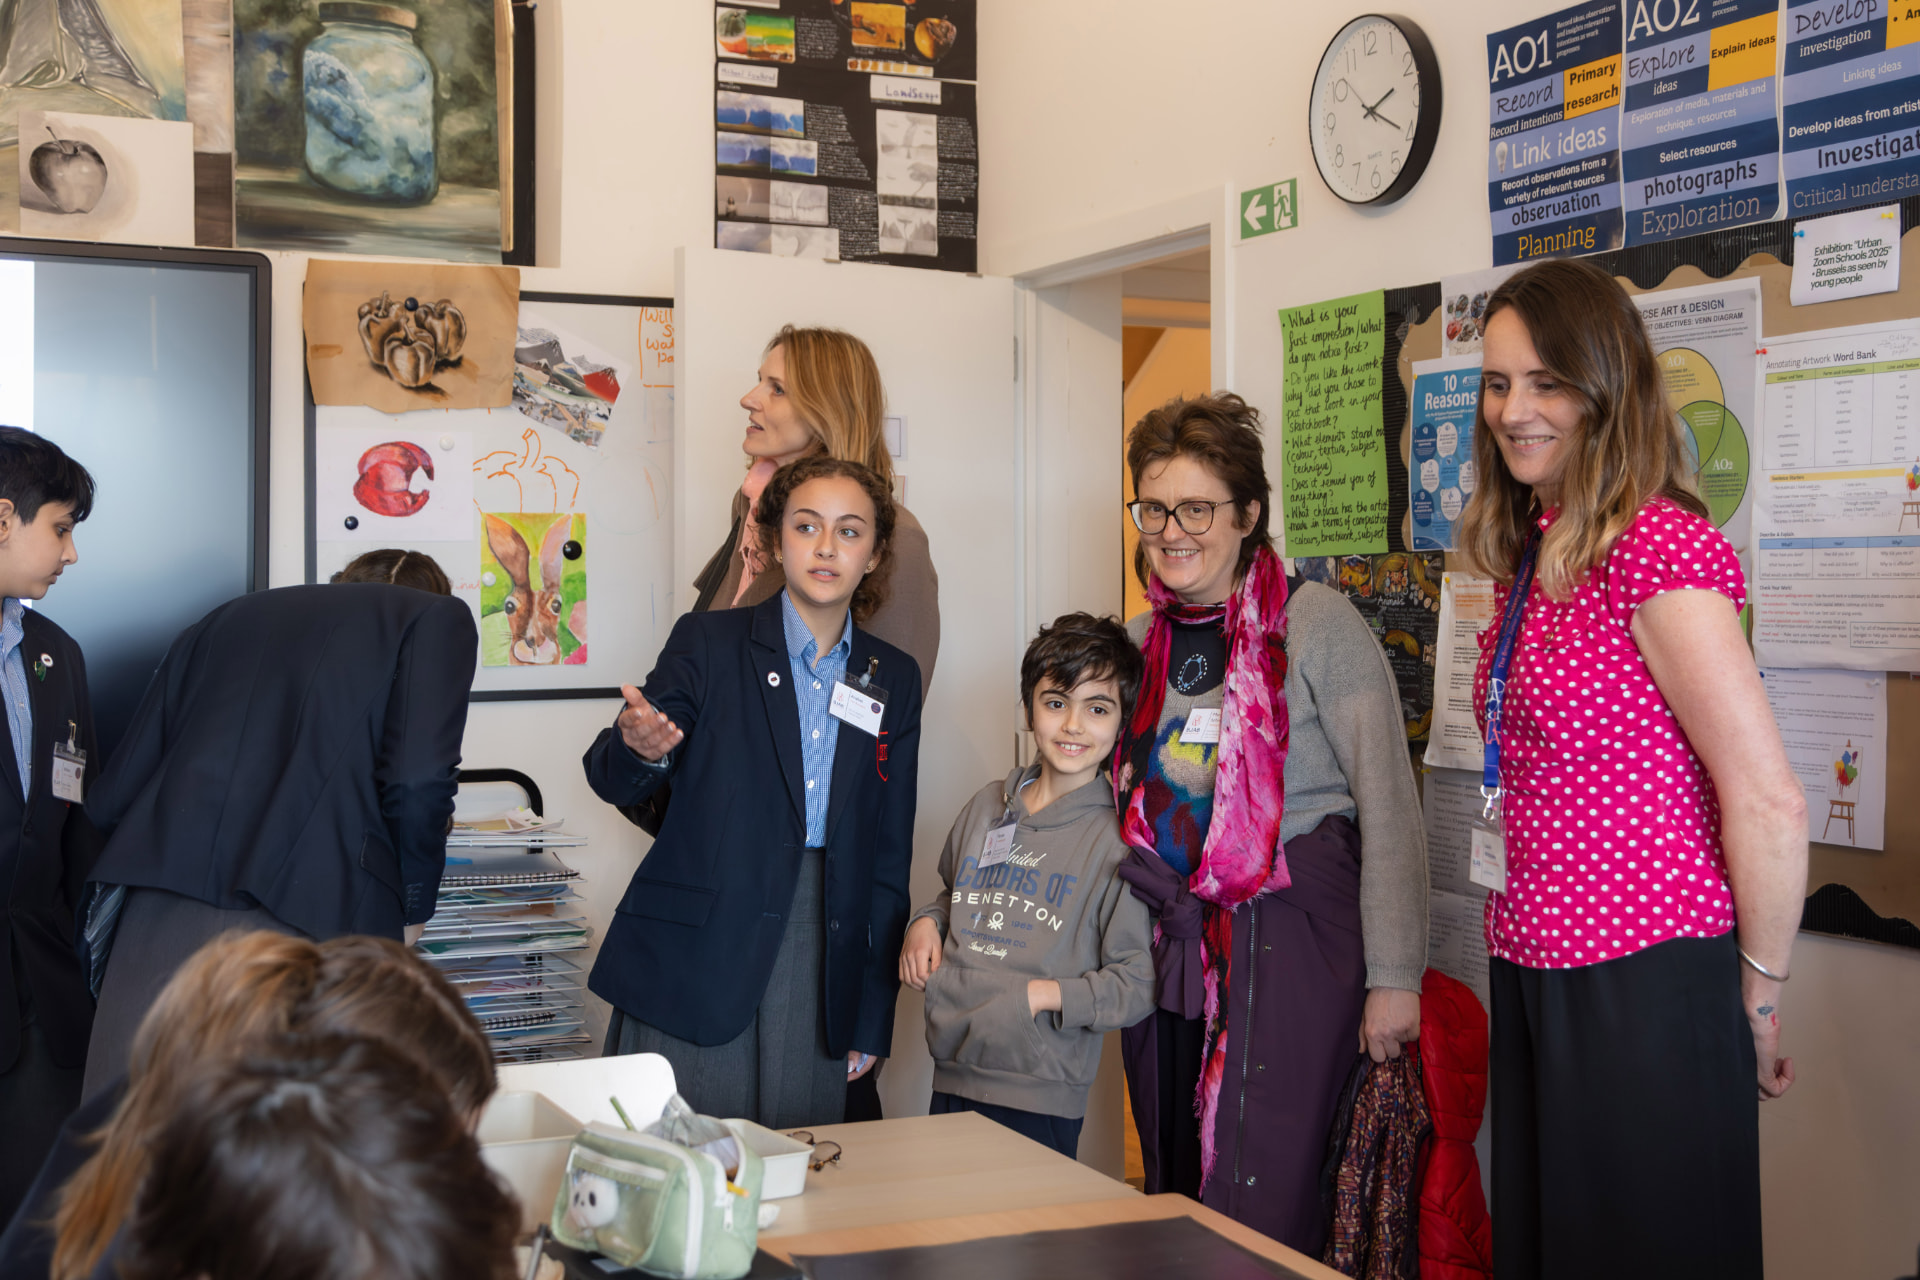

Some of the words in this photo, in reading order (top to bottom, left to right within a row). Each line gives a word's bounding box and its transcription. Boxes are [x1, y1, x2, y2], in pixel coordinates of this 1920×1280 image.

[1628, 0, 1700, 42] AO2
[1795, 0, 1877, 34] Develop
[1363, 30, 1377, 56] 12
[1388, 31, 1393, 55] 1
[1711, 43, 1746, 59] Explain
[1749, 34, 1776, 49] ideas
[1799, 29, 1871, 57] investigation
[1345, 48, 1356, 73] 11
[1402, 51, 1414, 77] 2
[1491, 30, 1552, 83] AO1
[1628, 44, 1695, 79] Explore
[1570, 63, 1616, 85] Primary
[1843, 67, 1875, 83] Linking
[1878, 60, 1902, 74] ideas
[1332, 78, 1348, 104] 10
[1497, 78, 1553, 115] Record
[1566, 84, 1619, 111] research
[1653, 80, 1678, 96] ideas
[1631, 103, 1673, 124] Exploration
[1675, 101, 1683, 113] of
[1712, 86, 1748, 104] materials
[1750, 81, 1766, 94] and
[1697, 107, 1737, 124] resources
[1326, 112, 1336, 136] 9
[1405, 120, 1414, 142] 4
[1490, 120, 1518, 139] Record
[1521, 110, 1563, 130] intentions
[1789, 121, 1832, 138] Develop
[1834, 113, 1863, 128] ideas
[1865, 108, 1890, 122] from
[1335, 144, 1344, 168] 8
[1512, 135, 1552, 169] Link
[1558, 126, 1606, 157] ideas
[1660, 147, 1688, 163] Select
[1690, 139, 1737, 157] resources
[1352, 162, 1361, 186] 7
[1391, 150, 1400, 175] 5
[1502, 176, 1529, 192] Record
[1531, 164, 1580, 184] observations
[1581, 159, 1600, 171] from
[1601, 157, 1607, 166] a
[1371, 164, 1381, 189] 6
[1504, 191, 1532, 206] variety
[1532, 188, 1539, 198] of
[1540, 181, 1572, 197] relevant
[1573, 173, 1605, 189] sources
[1644, 161, 1757, 205] photographs
[1793, 182, 1847, 208] Critical
[1511, 192, 1601, 226] observation
[1642, 195, 1760, 236] Exploration
[1518, 226, 1596, 259] Planning
[1815, 242, 1853, 256] Exhibition:
[1813, 256, 1835, 267] Zoom
[1836, 249, 1867, 264] Schools
[1816, 263, 1847, 277] Brussels
[1847, 264, 1856, 272] as
[1857, 261, 1877, 271] seen
[1877, 258, 1888, 269] by
[1811, 277, 1835, 291] young
[1835, 272, 1863, 286] people
[1288, 308, 1315, 328] What
[1320, 311, 1330, 321] is
[1335, 304, 1358, 330] your
[1639, 307, 1659, 320] CSE
[1661, 305, 1678, 317] ART
[1681, 303, 1687, 314] &
[1689, 299, 1725, 313] DESIGN
[1695, 315, 1712, 325] VENN
[1713, 312, 1743, 322] DIAGRAM
[1766, 358, 1801, 369] Annotating
[1802, 353, 1831, 365] Artwork
[1833, 352, 1854, 362] Word
[1857, 349, 1877, 360] Bank
[1443, 374, 1457, 392] 10
[1425, 391, 1477, 410] Reasons
[955, 855, 1041, 897] COLORS
[1044, 873, 1078, 908] OF
[951, 891, 1063, 931] BENETTON
